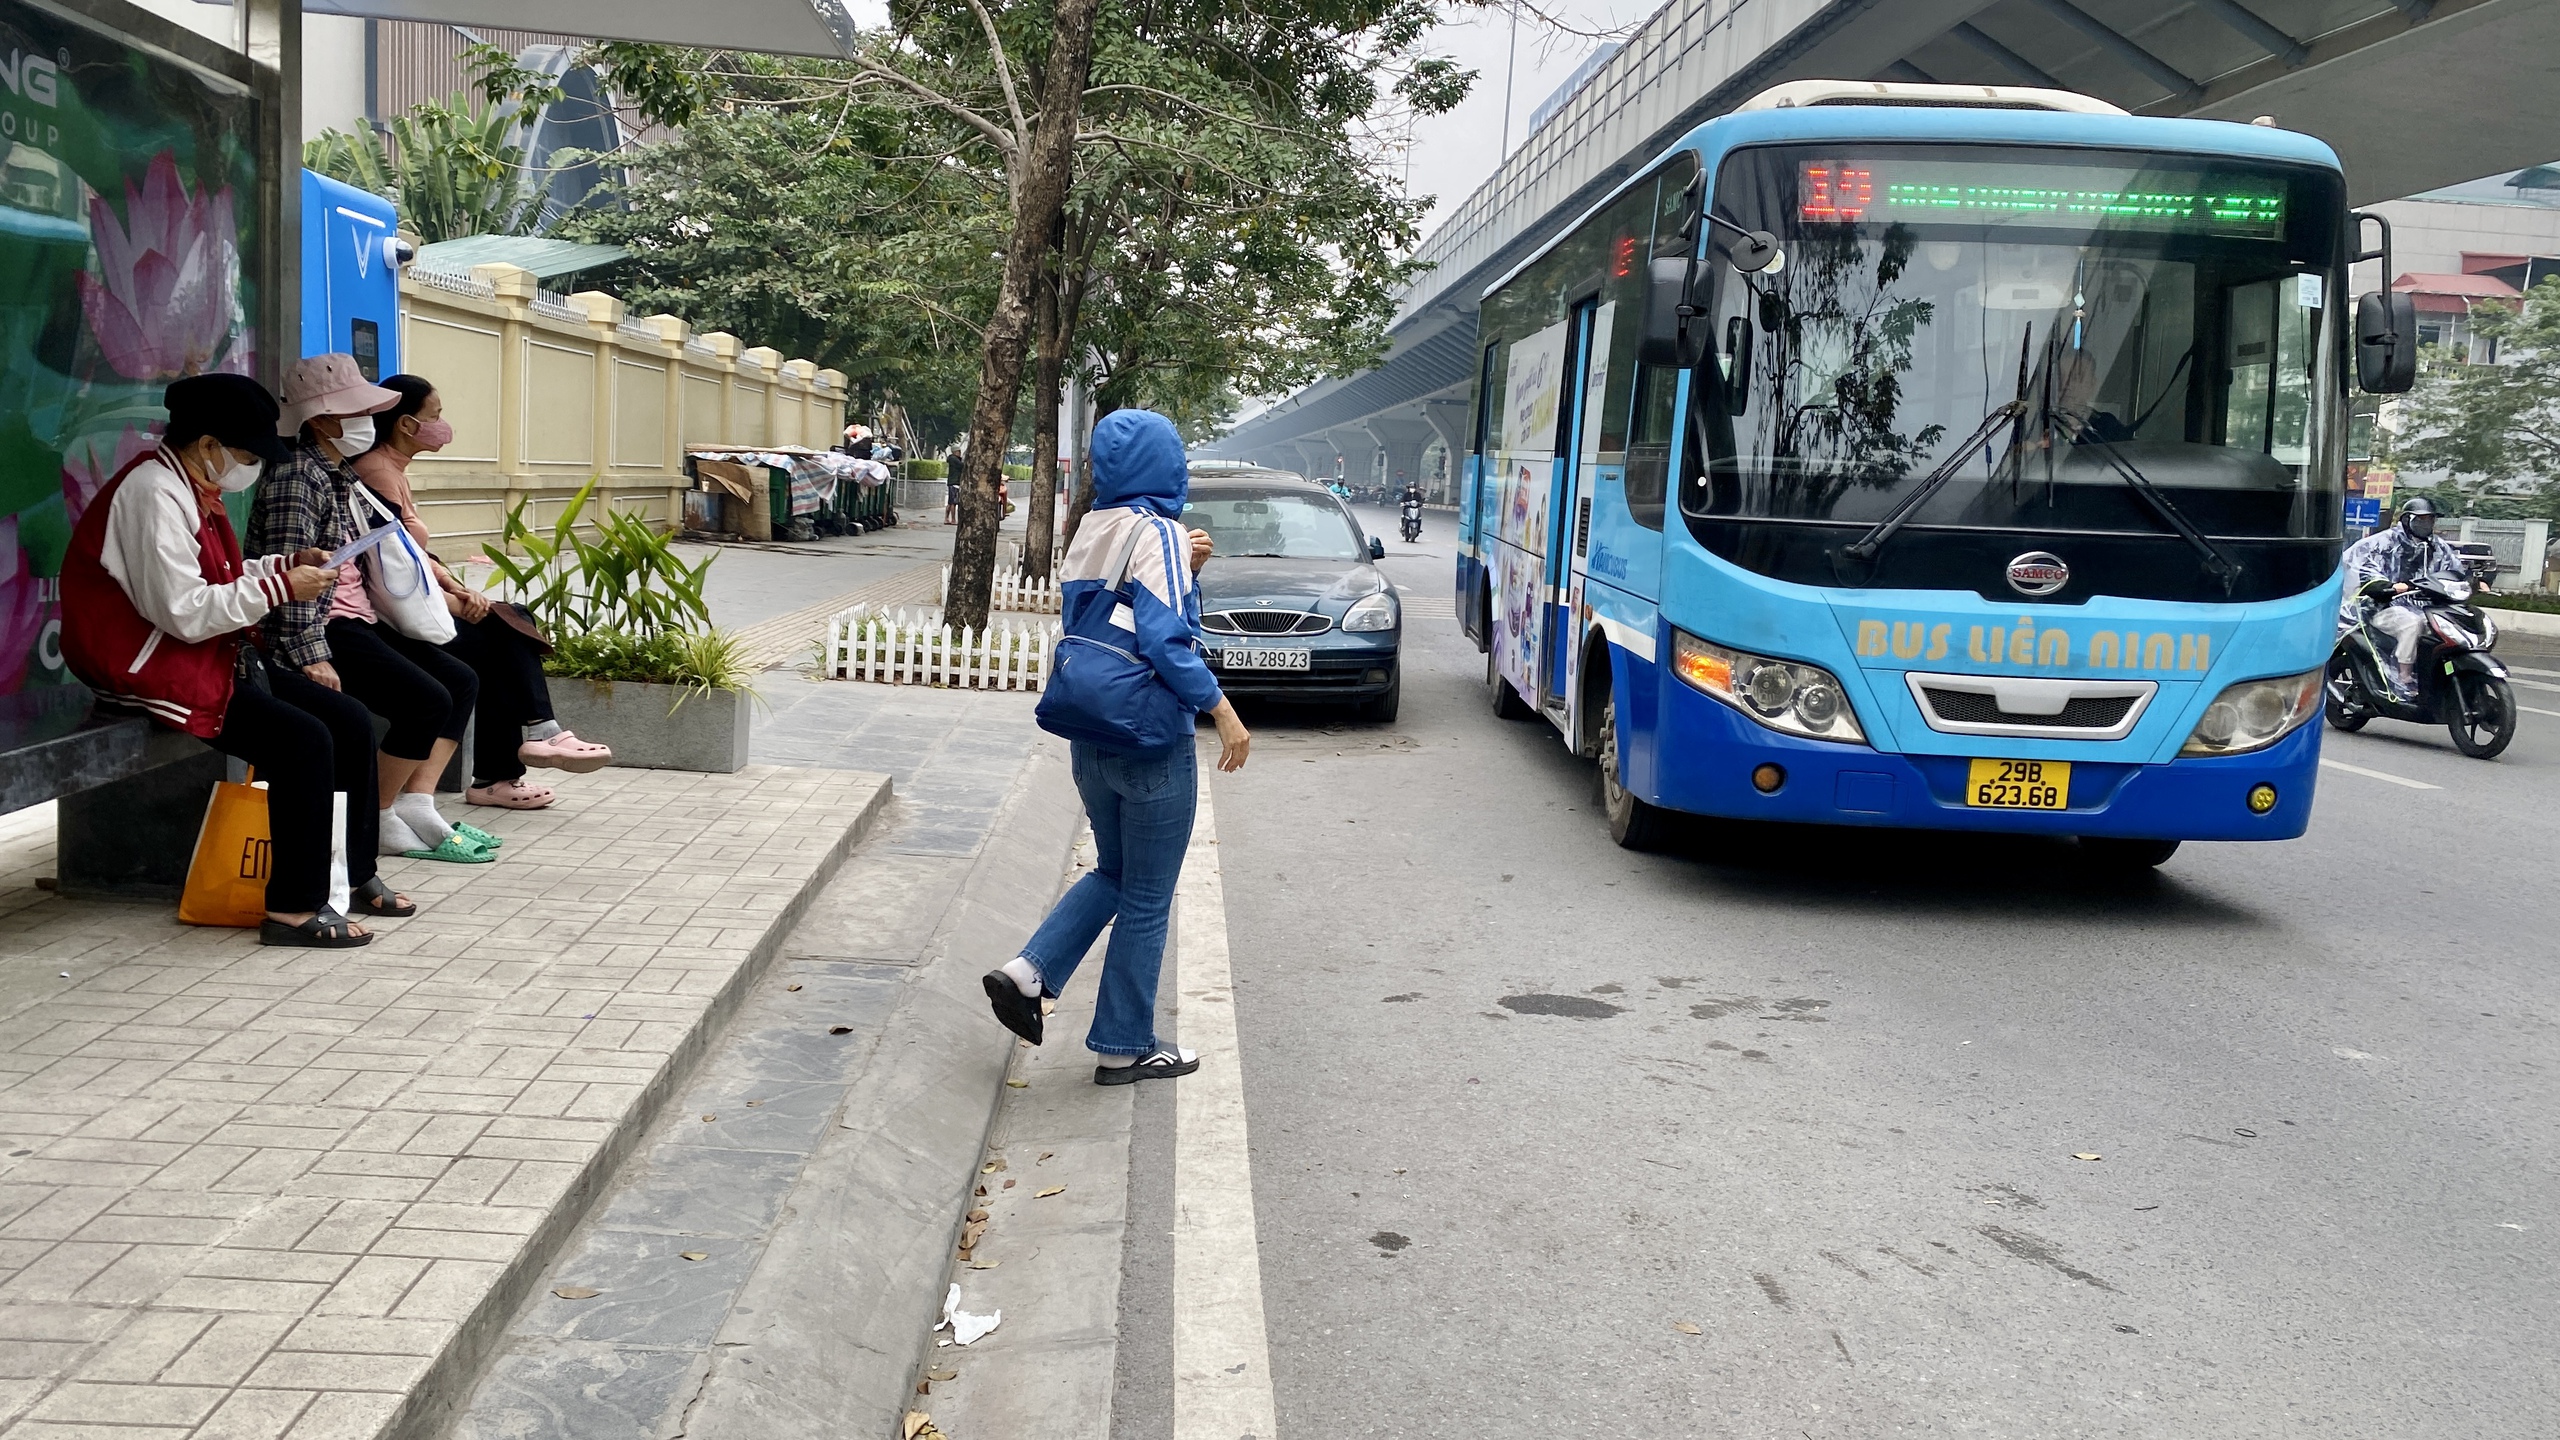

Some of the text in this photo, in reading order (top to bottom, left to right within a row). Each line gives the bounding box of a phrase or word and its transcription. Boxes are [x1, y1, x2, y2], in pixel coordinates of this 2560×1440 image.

[2011, 567, 2065, 580] SAMCO
[1857, 616, 2210, 671] BUS LIÊN NINH
[1998, 762, 2042, 783] 29B
[1977, 784, 2058, 807] 623.68
